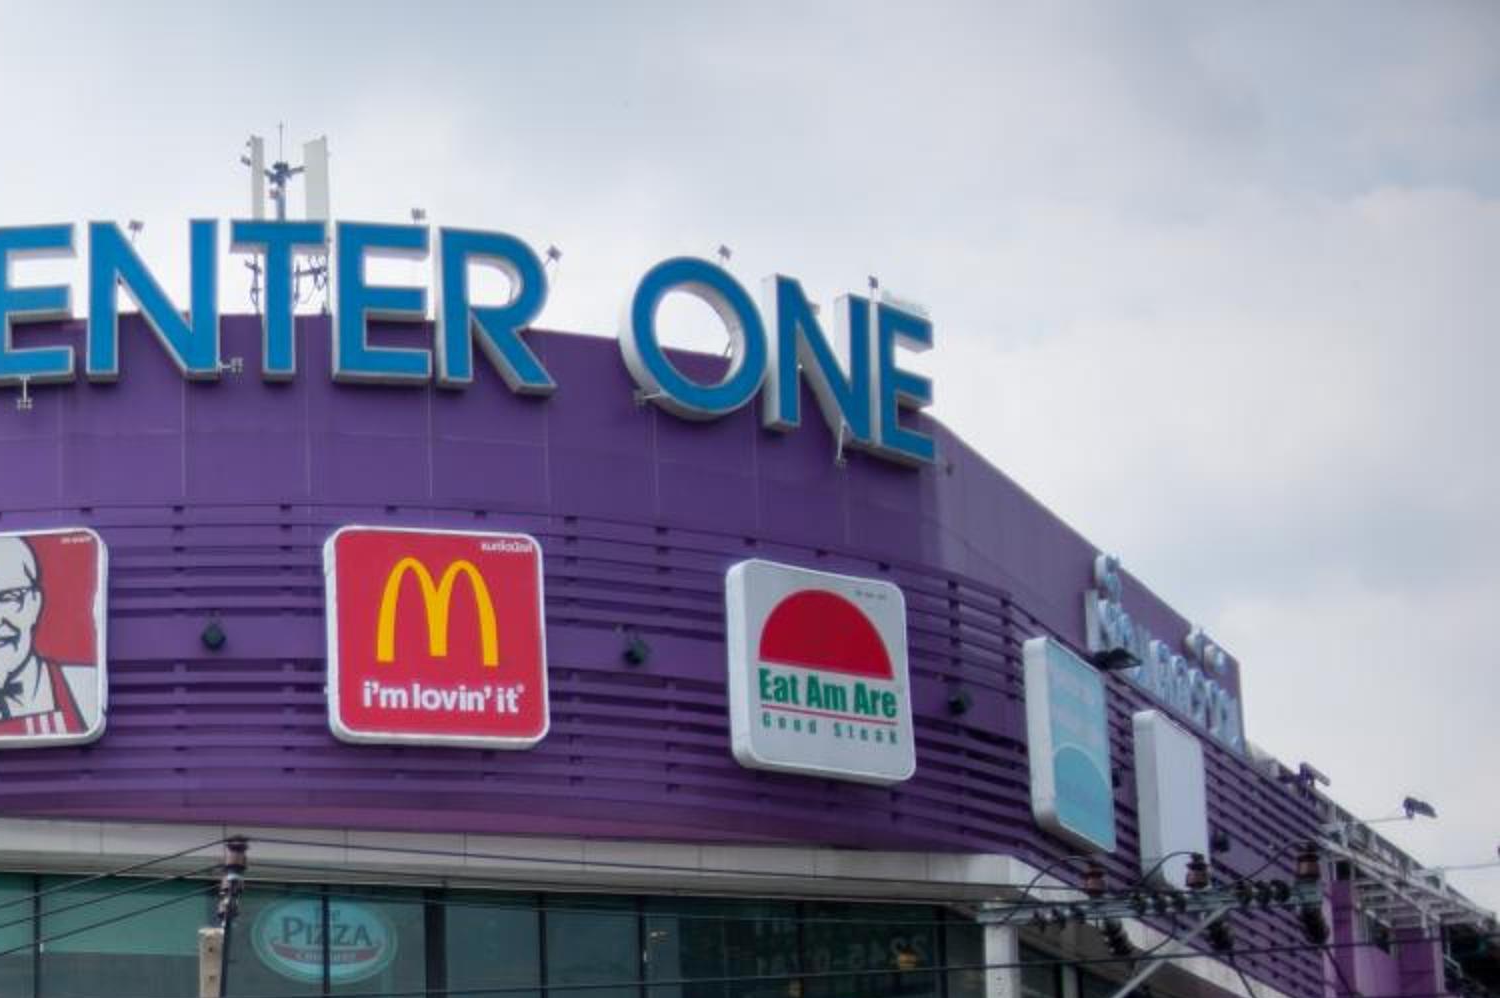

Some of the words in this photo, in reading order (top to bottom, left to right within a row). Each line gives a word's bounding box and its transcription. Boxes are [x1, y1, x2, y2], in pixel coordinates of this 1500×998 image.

[616, 254, 938, 469] ONE
[362, 680, 409, 709] i'm
[412, 682, 492, 714] lovin'
[496, 685, 520, 714] it
[757, 667, 800, 705] Eat
[806, 673, 847, 713] Am
[853, 682, 897, 719] Are
